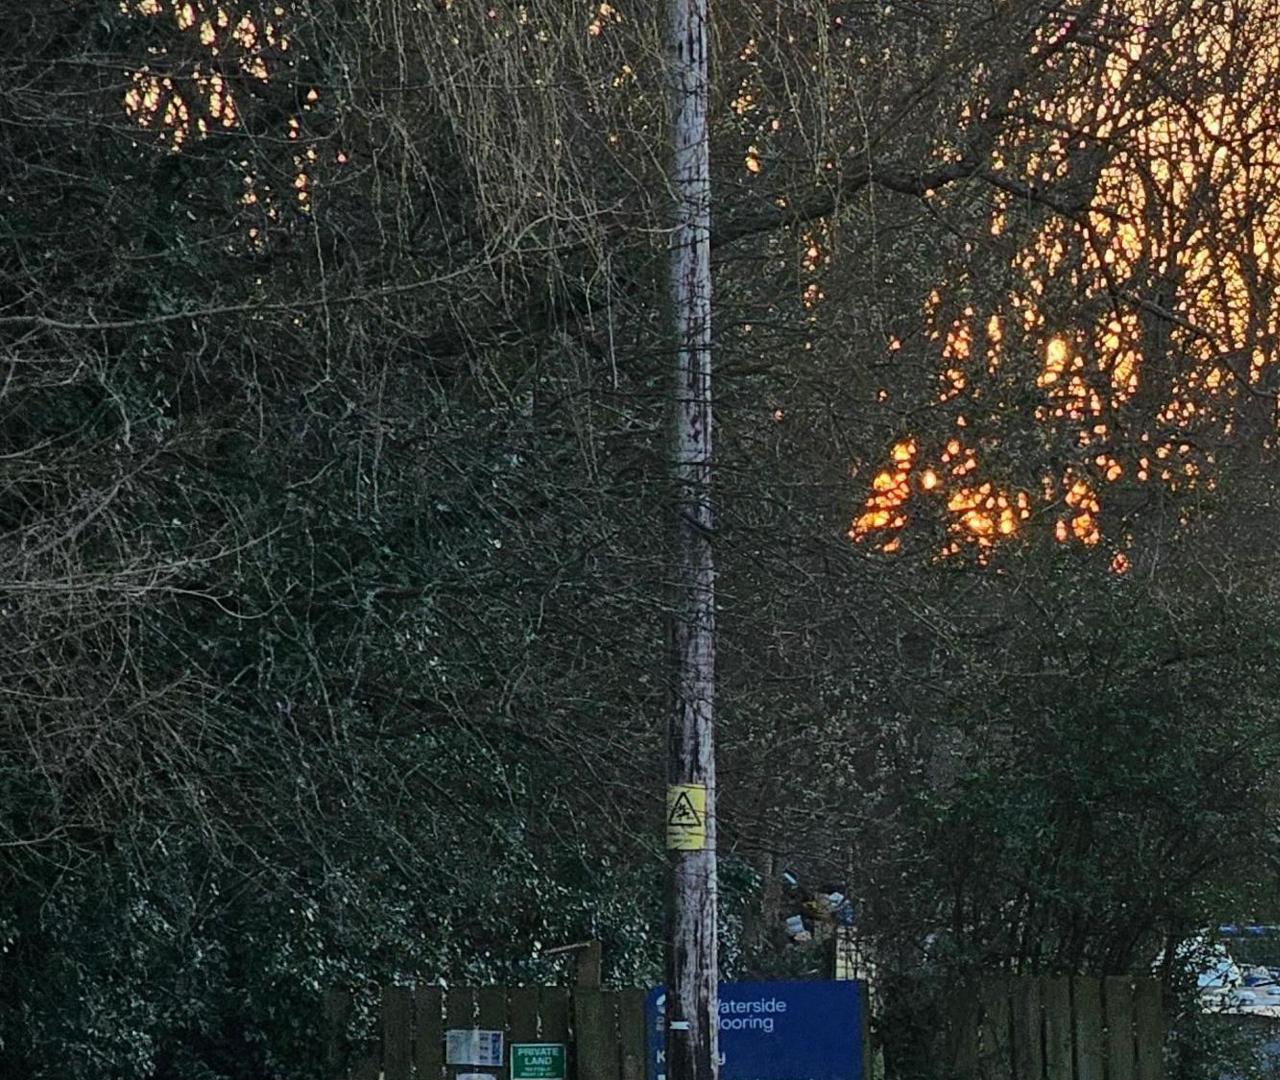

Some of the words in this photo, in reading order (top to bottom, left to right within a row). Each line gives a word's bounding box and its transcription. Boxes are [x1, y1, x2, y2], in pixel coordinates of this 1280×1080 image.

[717, 1014, 774, 1032] ooring
[517, 1047, 559, 1057] PRIVATE
[524, 1056, 553, 1066] LAND
